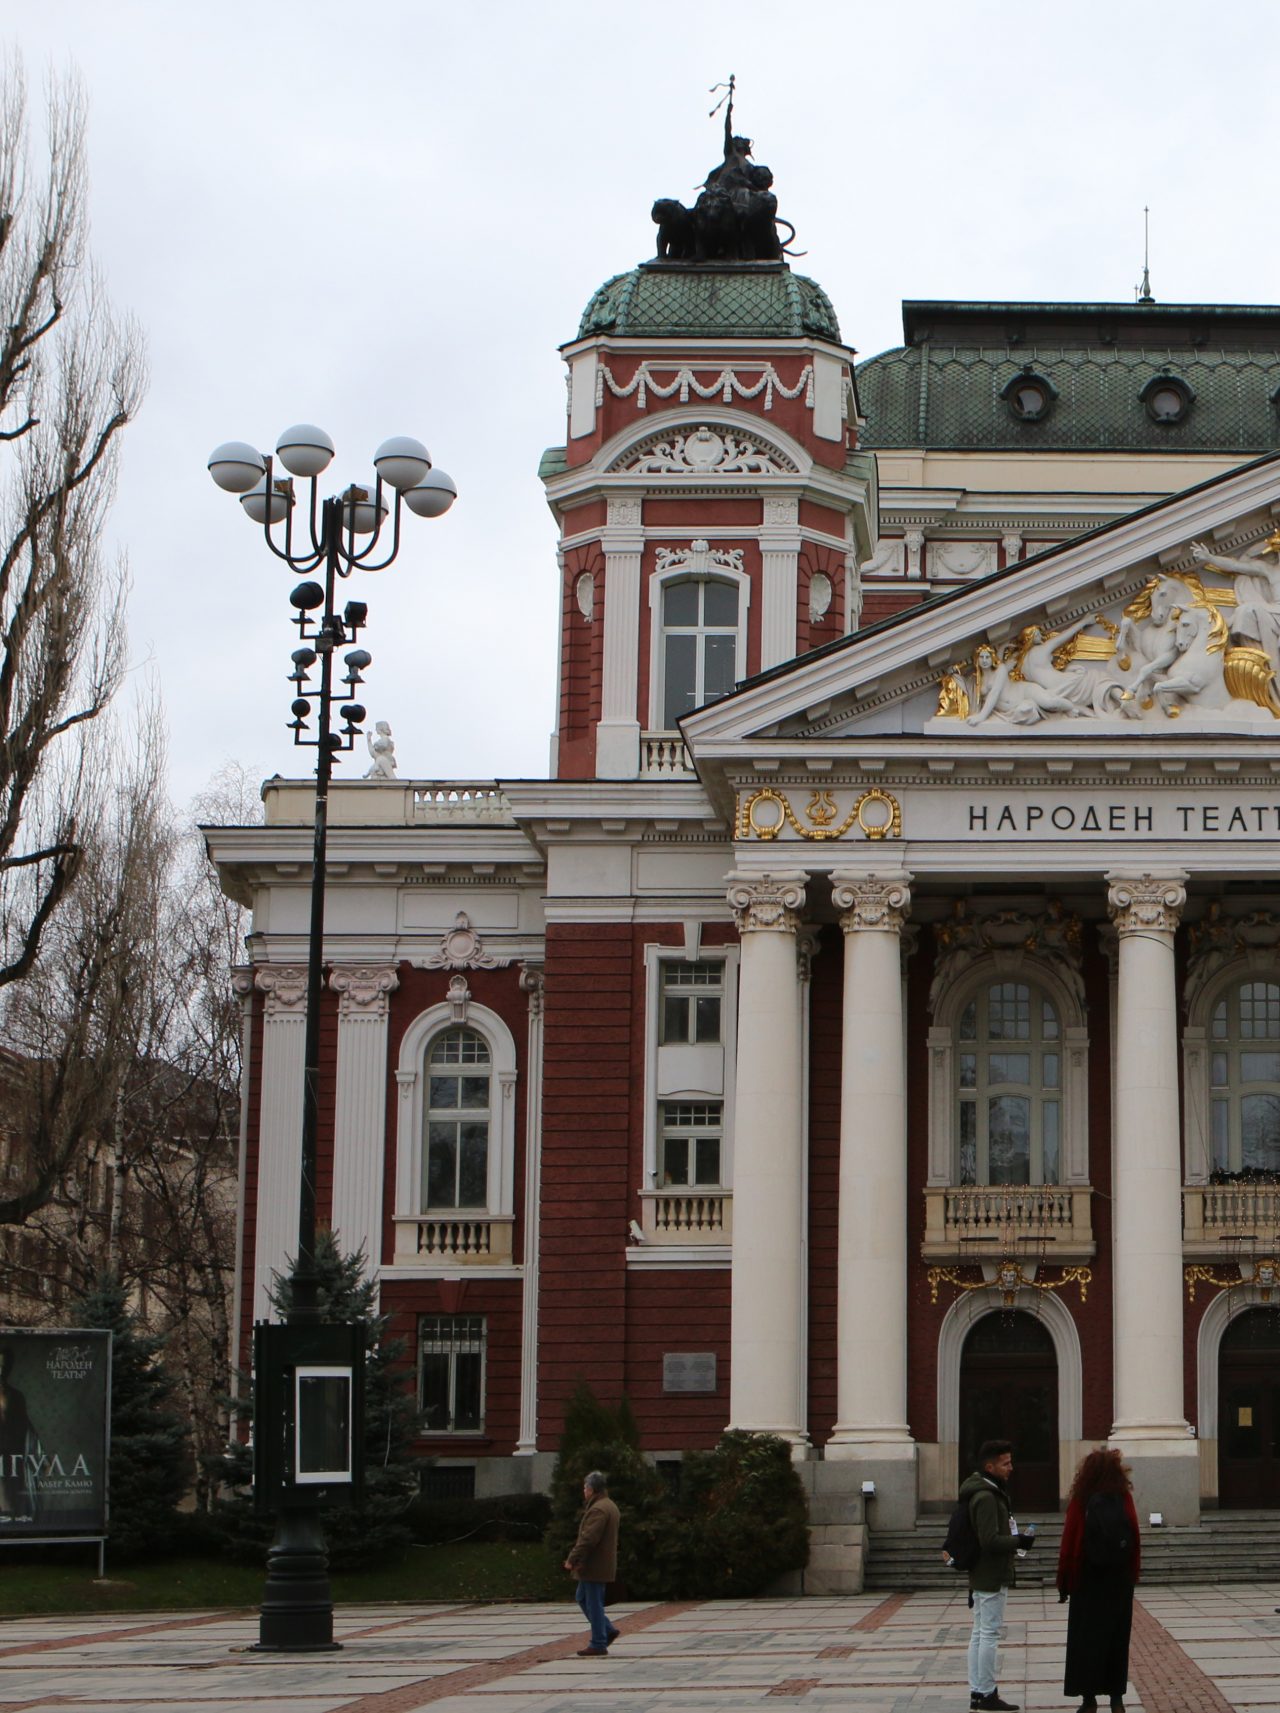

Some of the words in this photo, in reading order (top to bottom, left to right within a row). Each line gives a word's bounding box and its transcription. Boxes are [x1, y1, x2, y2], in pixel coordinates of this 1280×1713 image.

[968, 804, 1153, 832] НАРОДЕН
[46, 1360, 93, 1370] НАРОДЕН
[51, 1370, 87, 1380] ТЕАТЪР
